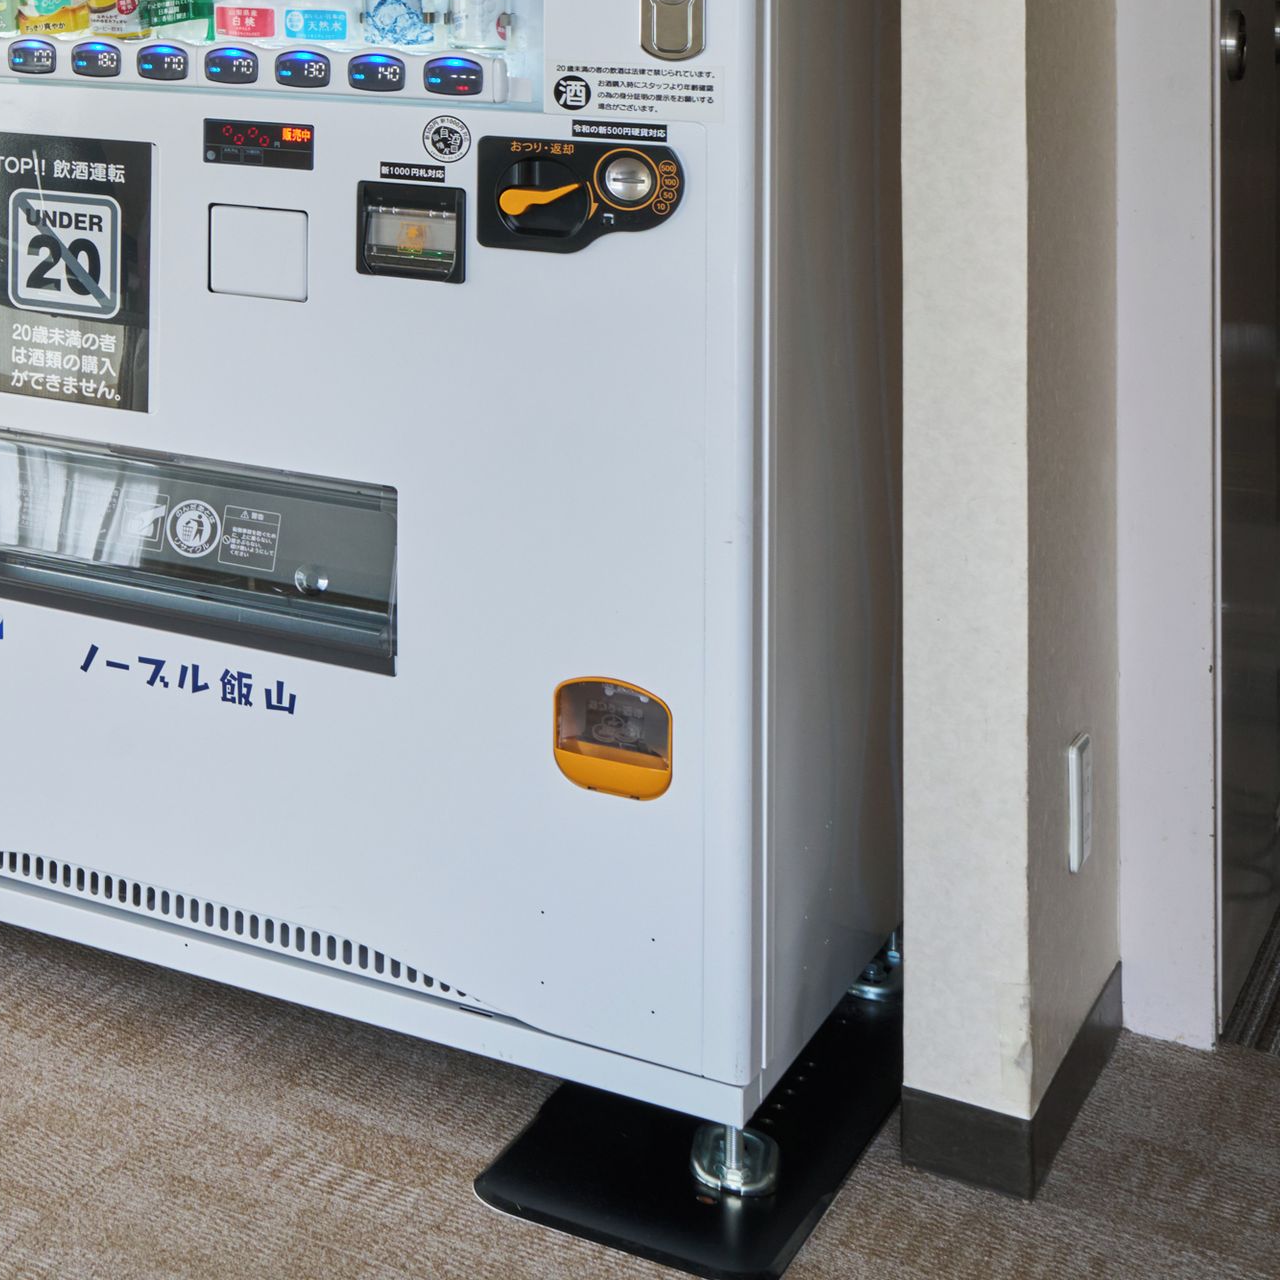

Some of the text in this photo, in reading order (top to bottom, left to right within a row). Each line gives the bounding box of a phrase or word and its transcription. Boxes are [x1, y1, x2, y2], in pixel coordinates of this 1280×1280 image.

[308, 21, 342, 32] 天然水
[164, 56, 184, 71] 170
[233, 59, 253, 74] 170
[304, 63, 325, 78] 130
[378, 66, 400, 81] 140
[559, 80, 586, 106] 酒
[282, 128, 311, 142] 販売中
[573, 124, 666, 138] 令和の新500円硬貨対応
[510, 141, 575, 155] おつり・返却
[53, 159, 126, 184] 飲酒運転
[381, 165, 445, 178] 新1000円札対応
[26, 209, 103, 233] UNDER
[26, 233, 101, 296] 20
[12, 324, 116, 352] 20歳未満の者
[12, 347, 116, 377] は酒類の購入
[11, 371, 122, 402] ができません。
[174, 537, 210, 554] リサイクル
[80, 644, 296, 714] ノーブル飯山
